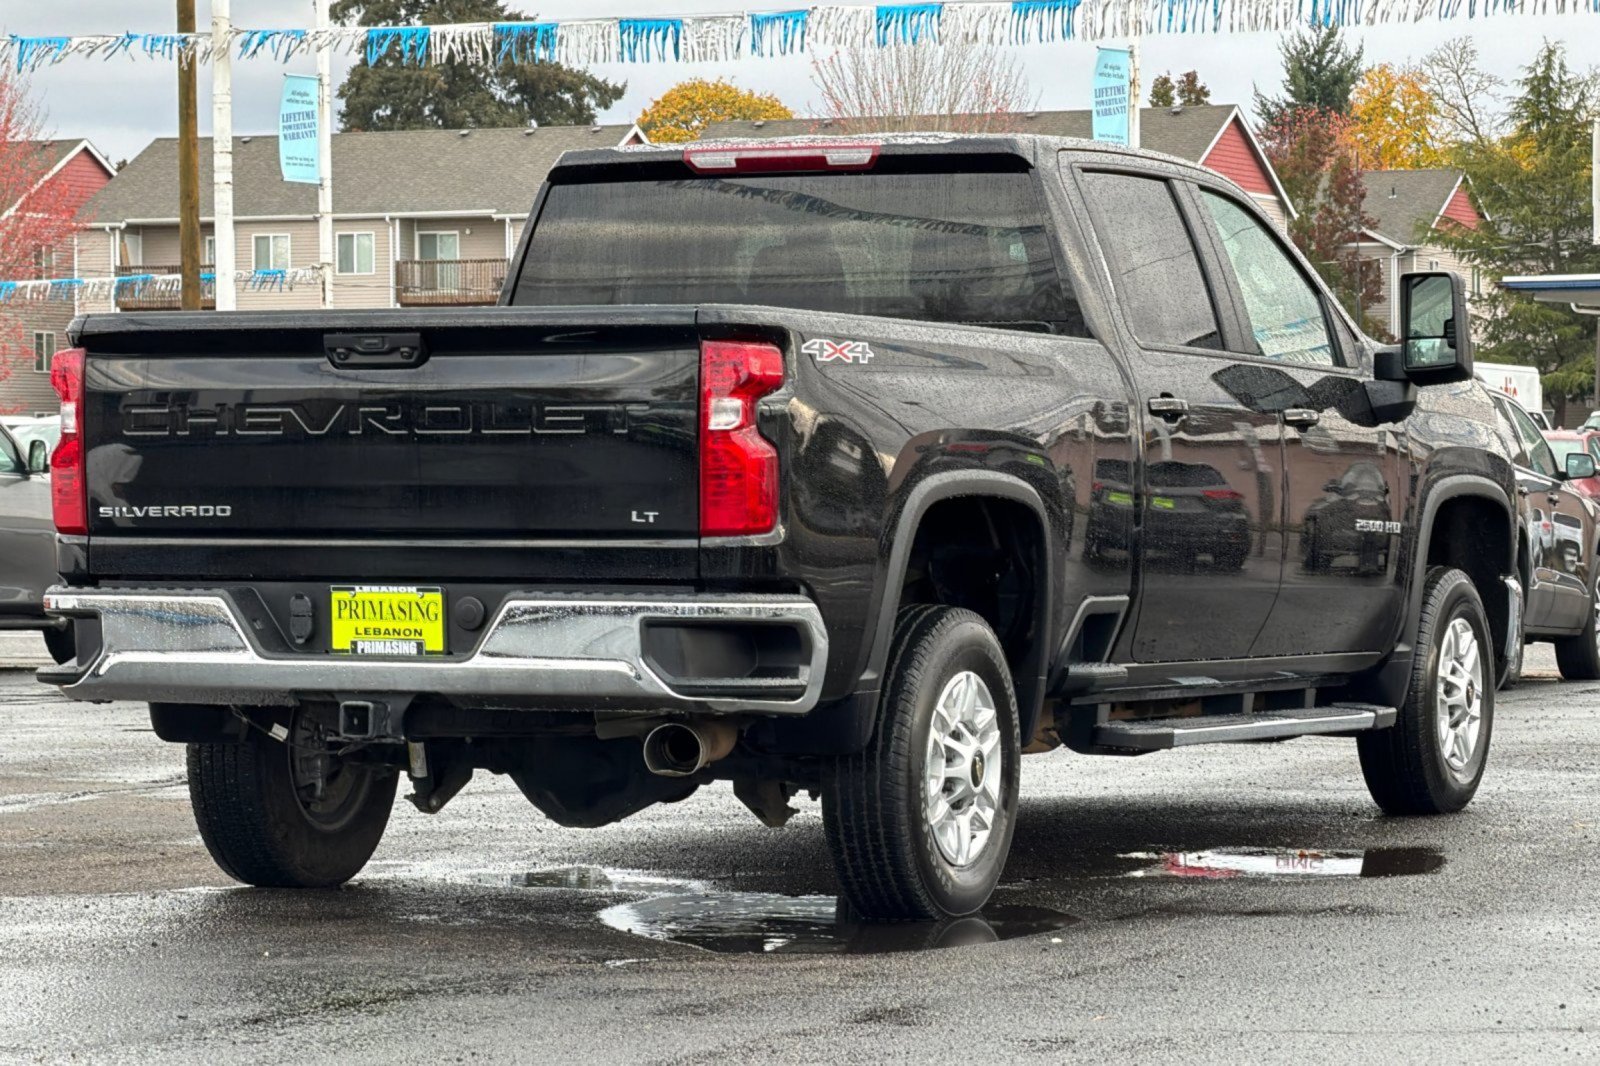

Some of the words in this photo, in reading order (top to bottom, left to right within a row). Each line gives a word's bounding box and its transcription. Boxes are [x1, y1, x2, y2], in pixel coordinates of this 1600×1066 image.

[1094, 85, 1126, 98] LIFETIME
[1095, 97, 1127, 108] POWERTRAIN
[281, 110, 316, 124] LIFETIME
[1095, 105, 1127, 117] WARRANTY
[282, 121, 317, 132] POWERTRAIN
[283, 130, 317, 141] WARRANTY
[122, 403, 650, 435] CHEVROLET
[99, 505, 232, 517] SILVERADO
[631, 510, 660, 523] LT
[1355, 518, 1384, 532] 2500
[1385, 520, 1401, 534] HD
[336, 599, 439, 622] PRIMASING
[354, 626, 423, 637] LEBANON
[356, 640, 418, 654] PRIMASING
